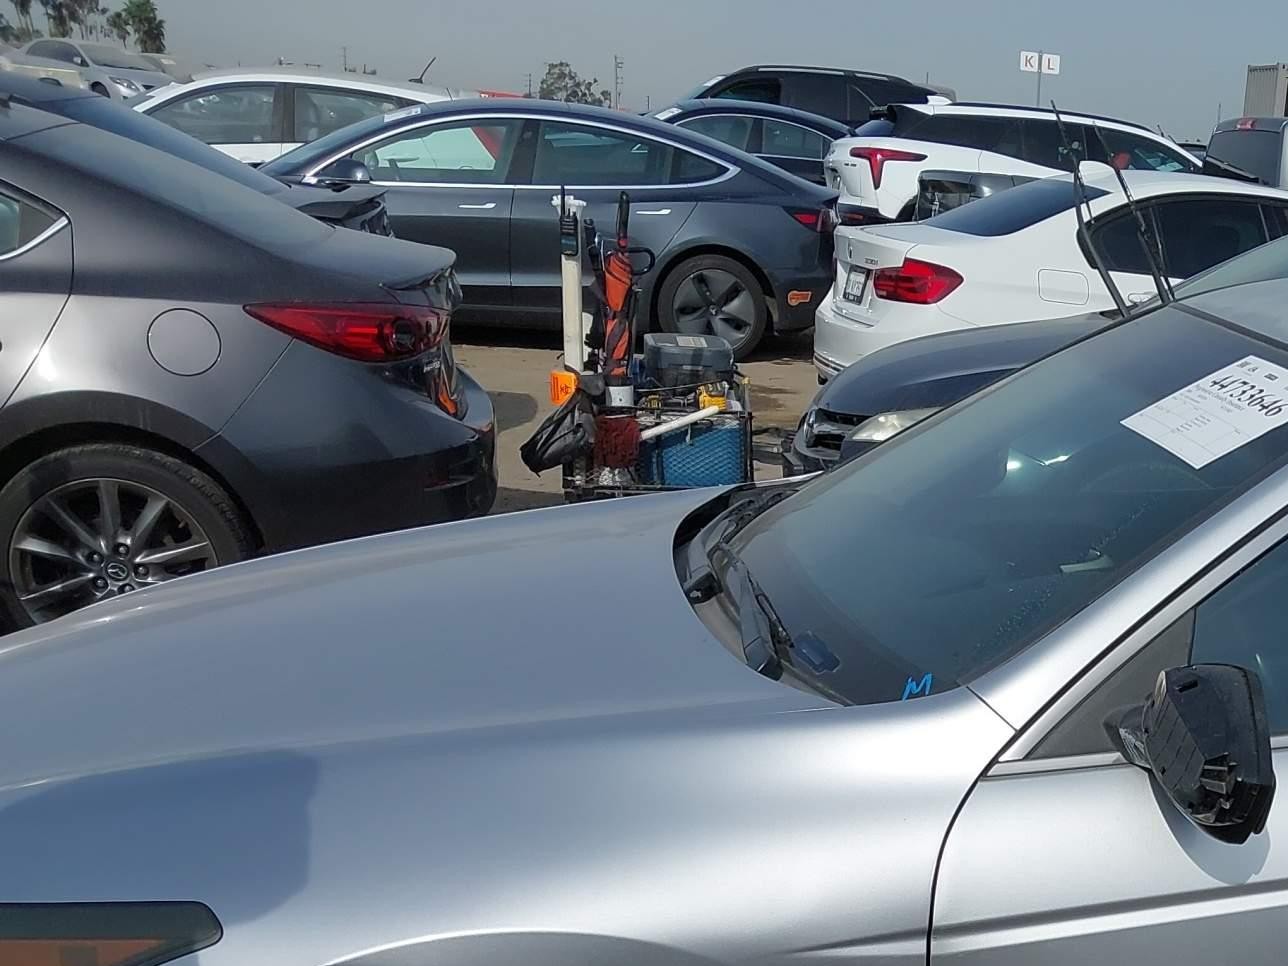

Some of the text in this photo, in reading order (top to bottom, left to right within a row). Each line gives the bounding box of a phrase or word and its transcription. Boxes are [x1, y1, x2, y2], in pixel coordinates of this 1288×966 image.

[1024, 55, 1034, 69] K
[1047, 57, 1056, 71] L
[901, 672, 933, 703] M
